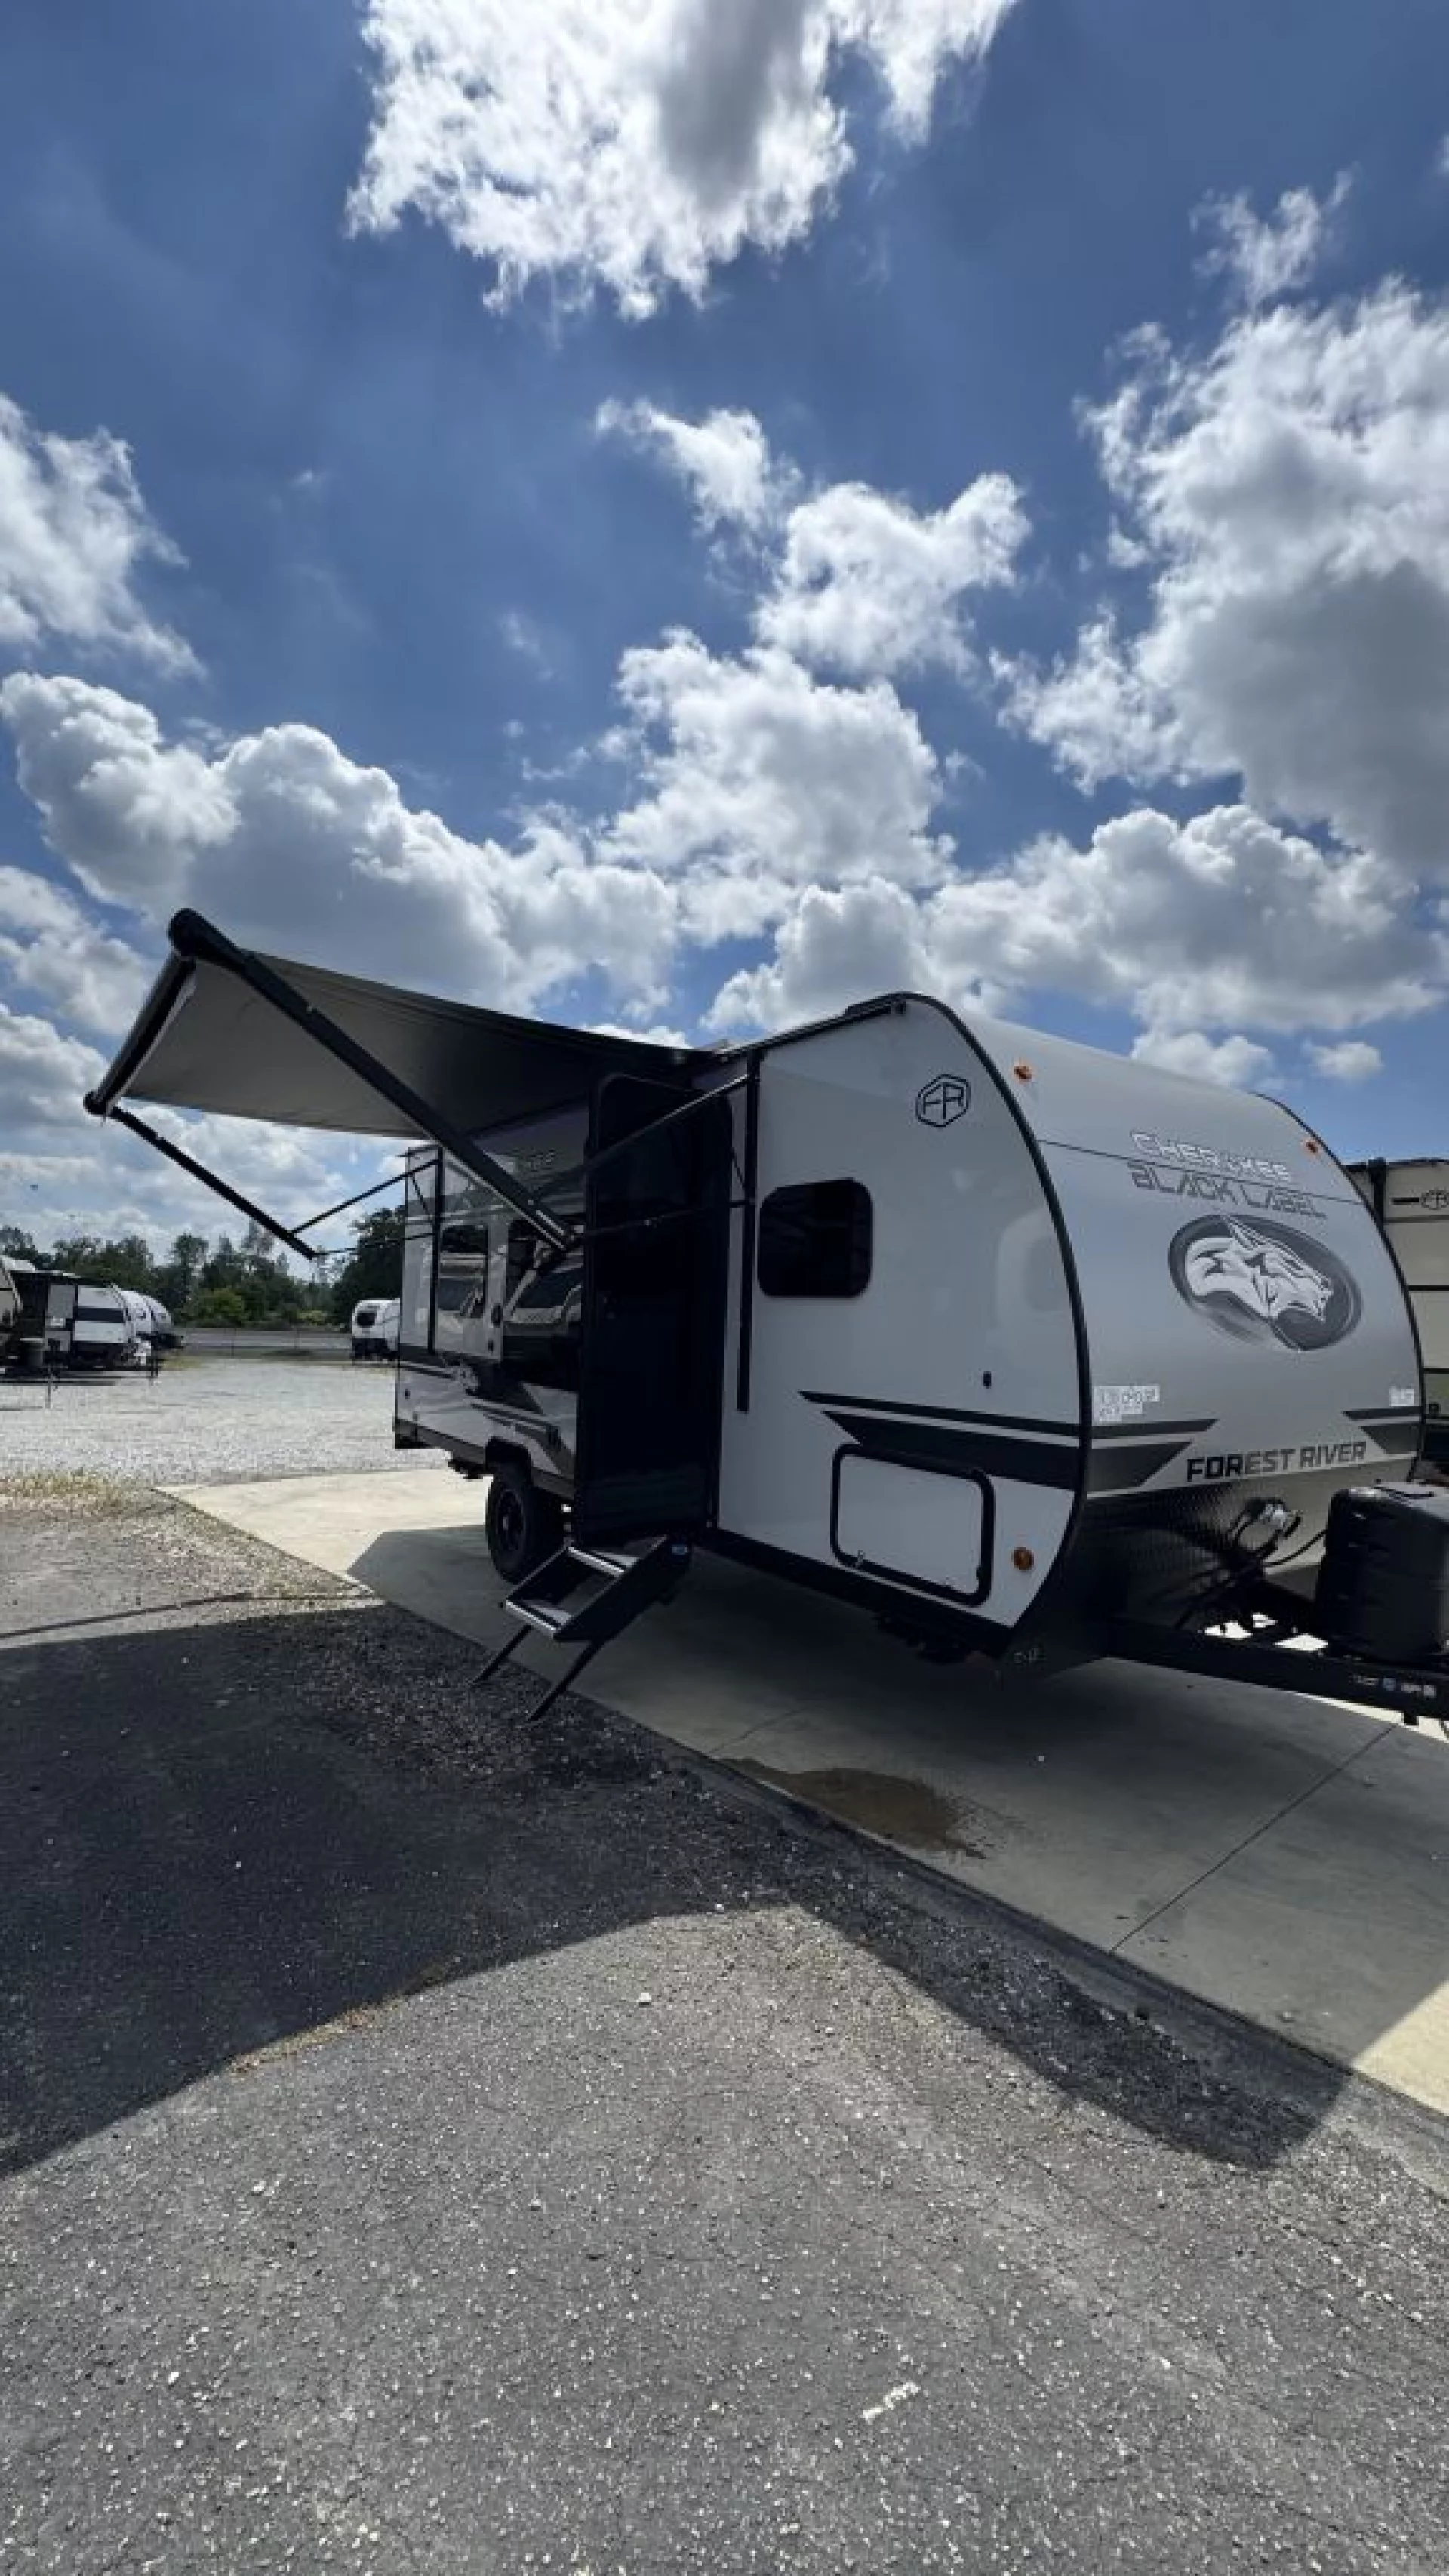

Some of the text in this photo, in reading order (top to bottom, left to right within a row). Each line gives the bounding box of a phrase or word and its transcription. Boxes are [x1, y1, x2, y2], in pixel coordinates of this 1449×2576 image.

[922, 1081, 964, 1120] FR
[1127, 1161, 1327, 1218] BLACK LABEL
[1186, 1441, 1367, 1482] FOREST RIVER
